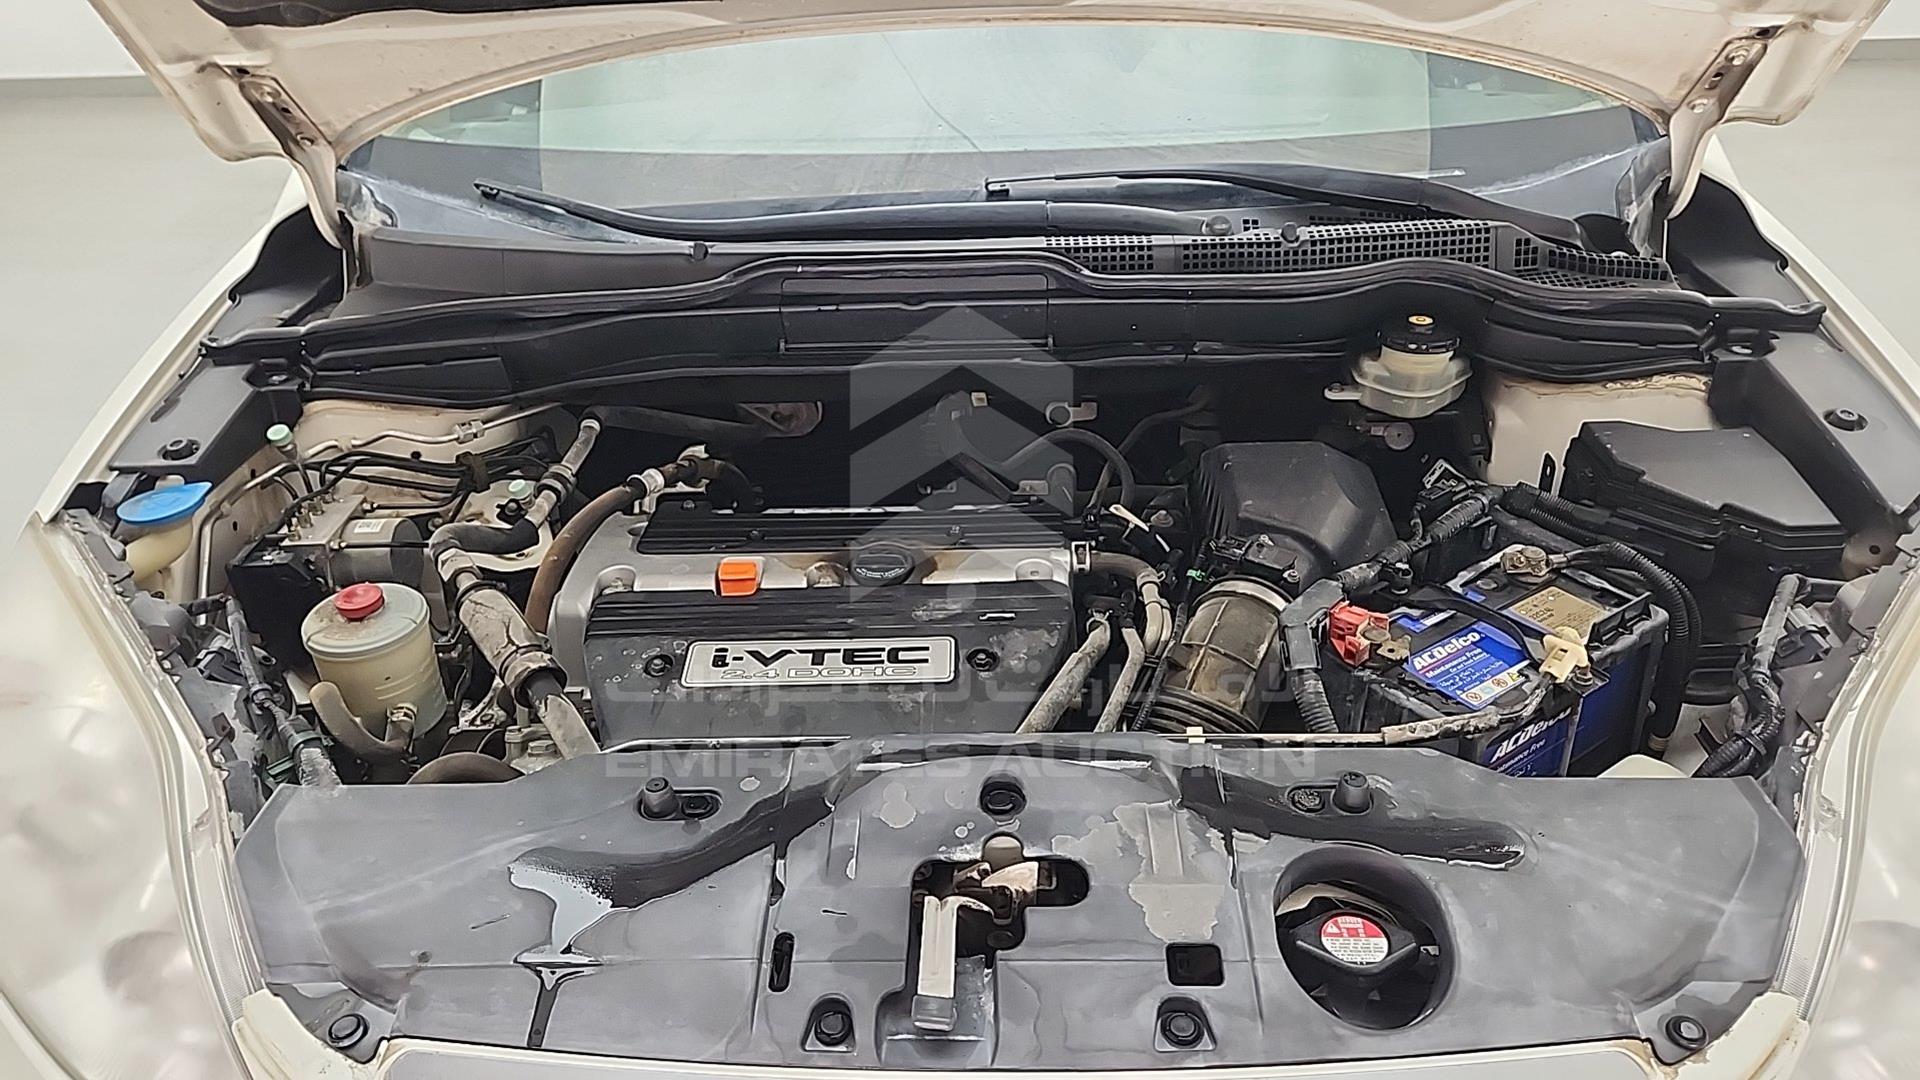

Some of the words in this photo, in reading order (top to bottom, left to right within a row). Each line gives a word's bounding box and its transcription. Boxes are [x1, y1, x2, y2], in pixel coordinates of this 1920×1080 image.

[711, 646, 930, 668] i-VTEC
[1413, 631, 1481, 670] ACDelco
[721, 669, 779, 680] 2.4
[787, 666, 918, 679] DOHC
[1425, 654, 1467, 678] Maintenance
